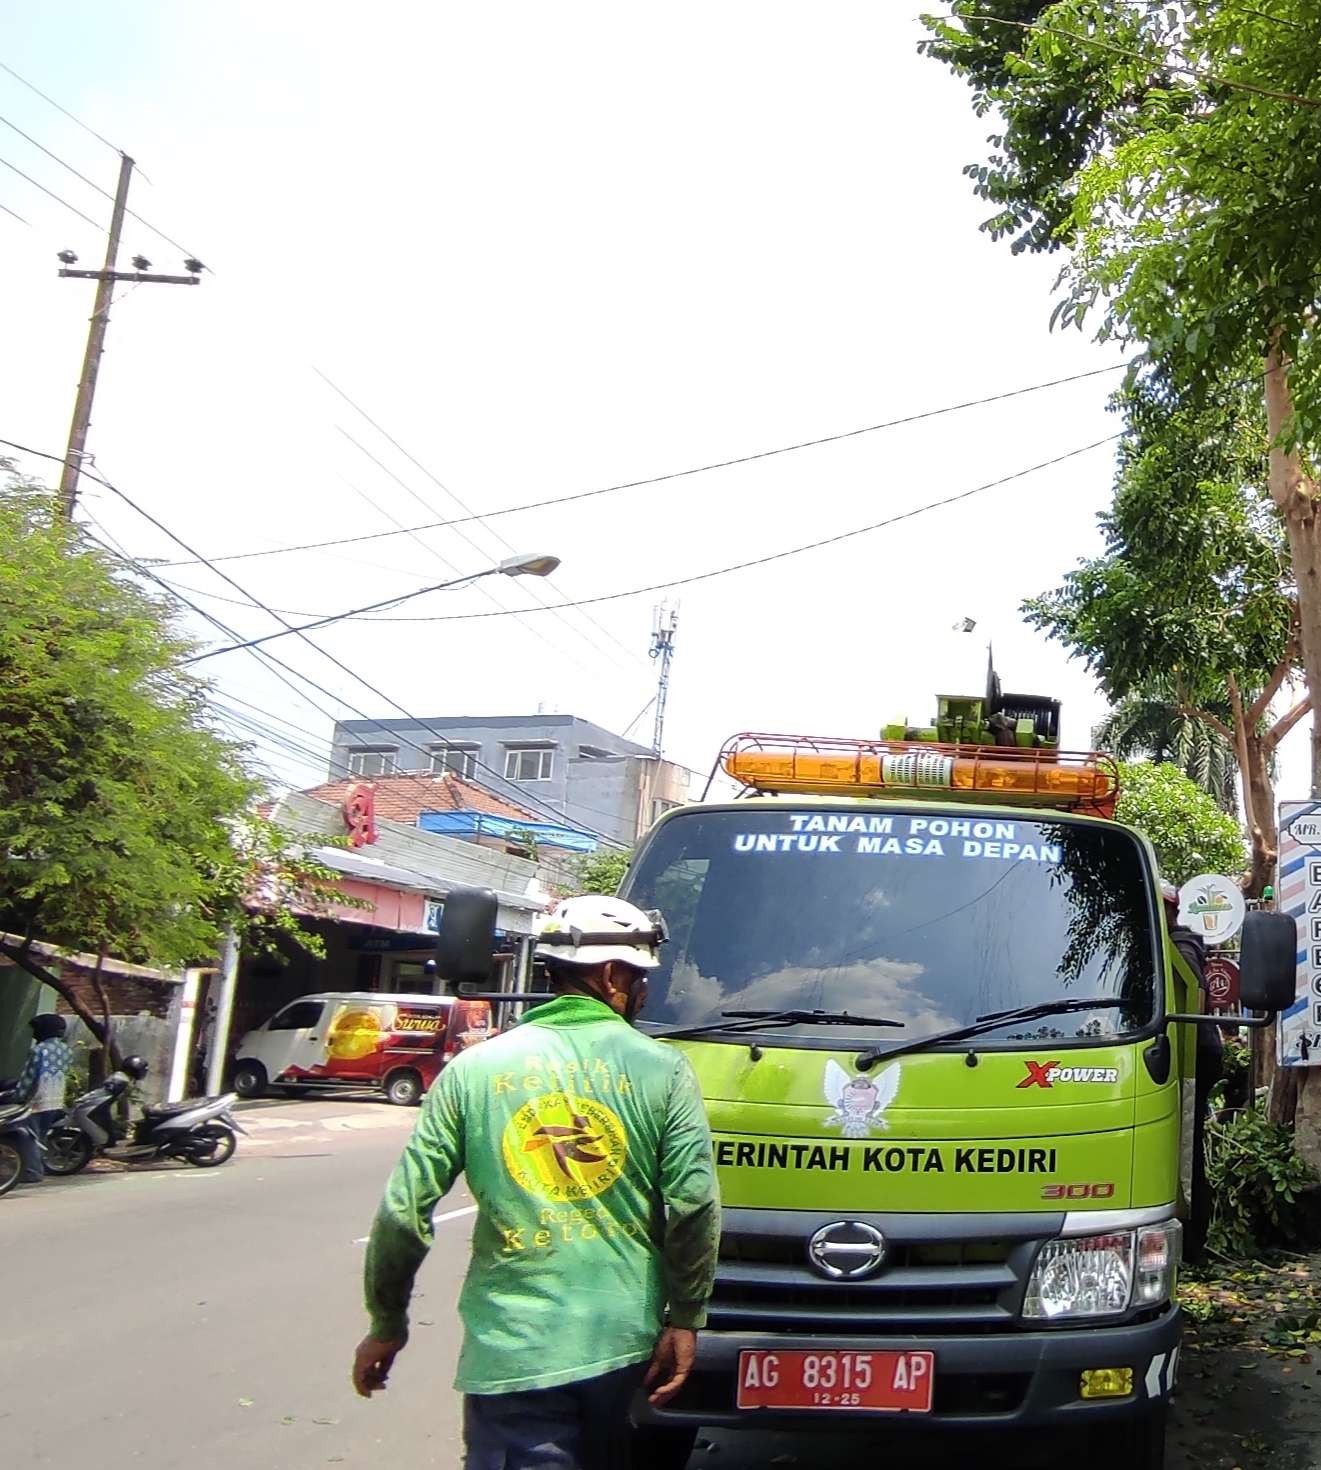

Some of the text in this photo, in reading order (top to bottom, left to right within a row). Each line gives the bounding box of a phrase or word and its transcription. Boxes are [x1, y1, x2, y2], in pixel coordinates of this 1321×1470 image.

[789, 815, 1014, 839] TANAM POHON
[734, 834, 1063, 863] UNTUK MASA DEPAN
[713, 1141, 1056, 1173] ERINTAH KOTA KEDIRI
[1041, 1184, 1114, 1199] 300
[745, 1355, 926, 1390] AG 8315 AP
[814, 1392, 860, 1405] 12-25
